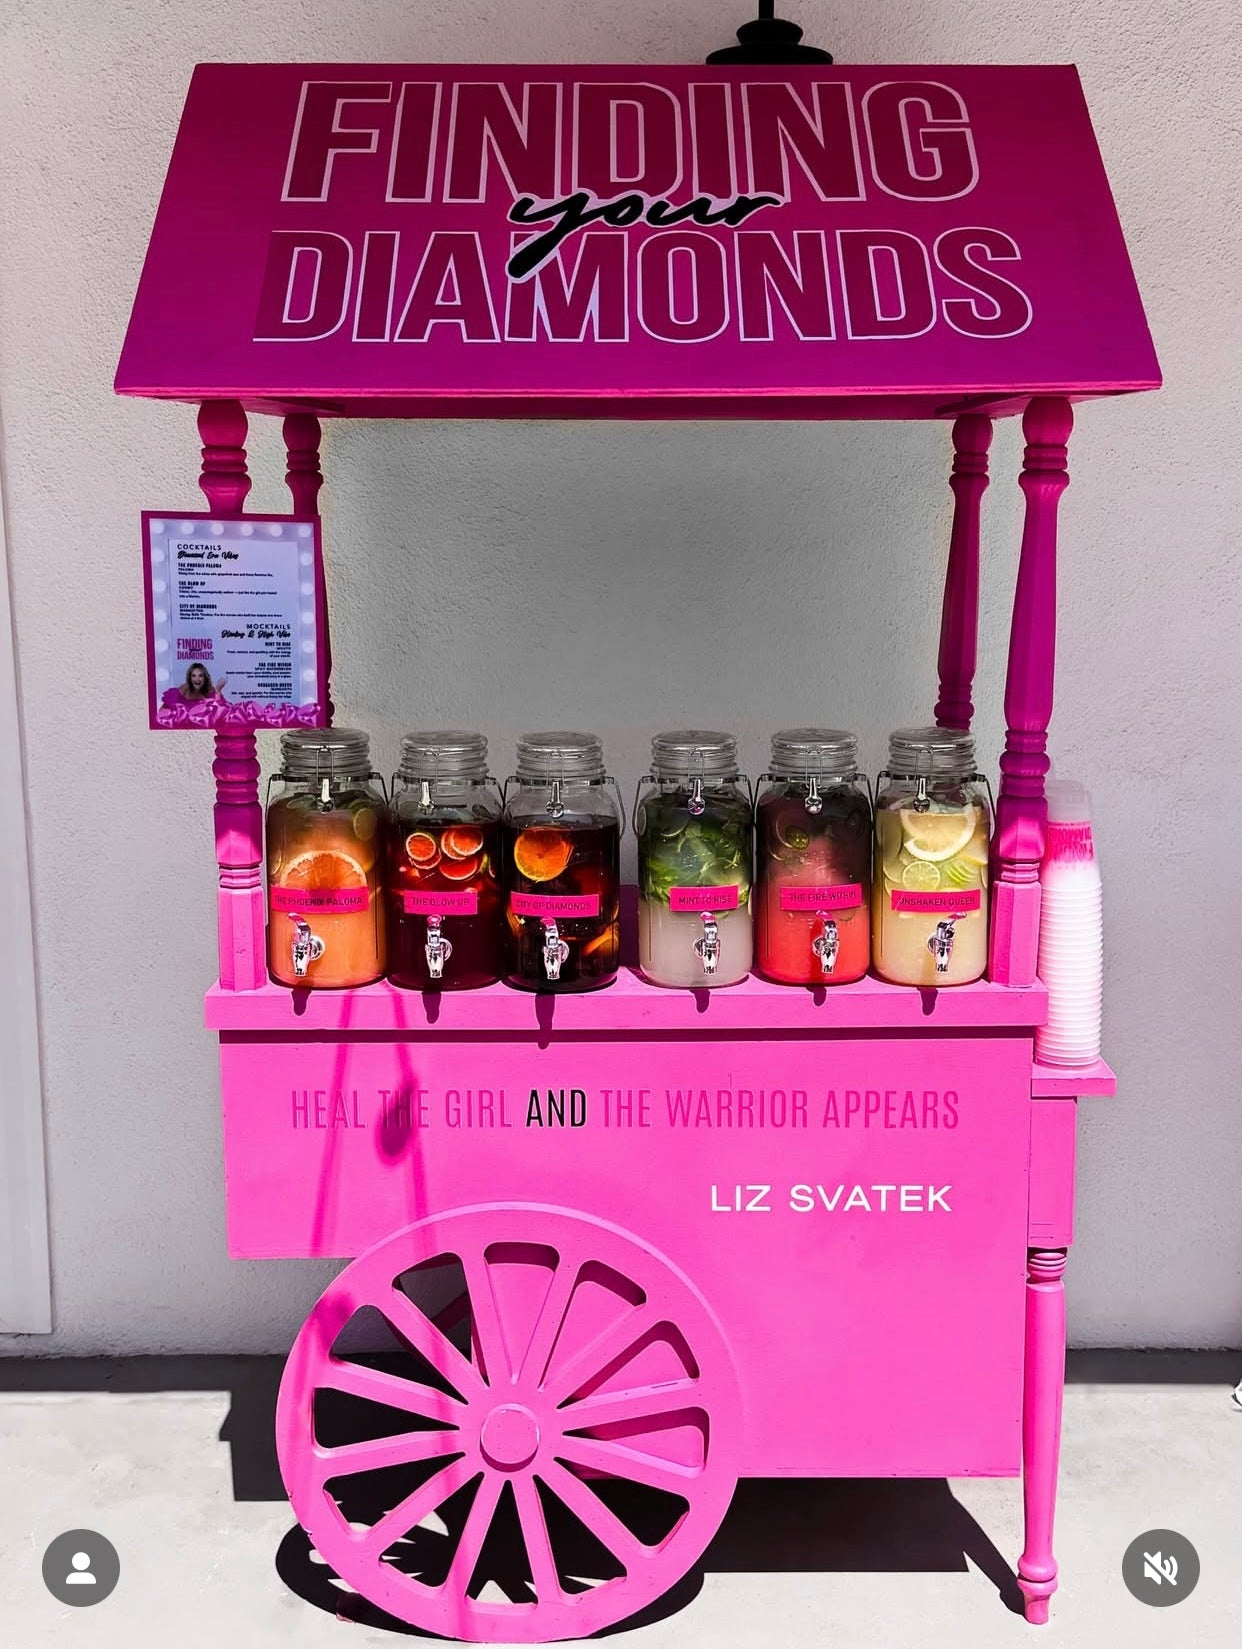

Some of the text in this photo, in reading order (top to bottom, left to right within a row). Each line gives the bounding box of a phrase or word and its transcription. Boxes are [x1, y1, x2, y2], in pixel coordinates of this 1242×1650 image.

[281, 81, 979, 202] FINDING
[507, 191, 785, 283] your
[253, 226, 1034, 342] DIAMONDS
[177, 638, 213, 649] FINDING
[177, 651, 214, 660] DIAMONDS
[273, 895, 362, 906] THE PHOENIX PALOMA
[411, 896, 428, 906] THE
[457, 897, 469, 906] UP
[679, 895, 733, 905] MINT TO RISE
[789, 892, 804, 902] THE
[807, 893, 827, 902] FIRE
[949, 896, 975, 906] QUEEN
[516, 900, 592, 910] CITY OF DIAMONDS
[291, 1088, 960, 1130] HEAL THE GIRL AND THE WARRIOR APPEARS
[710, 1184, 953, 1213] LIZ SVATEK
